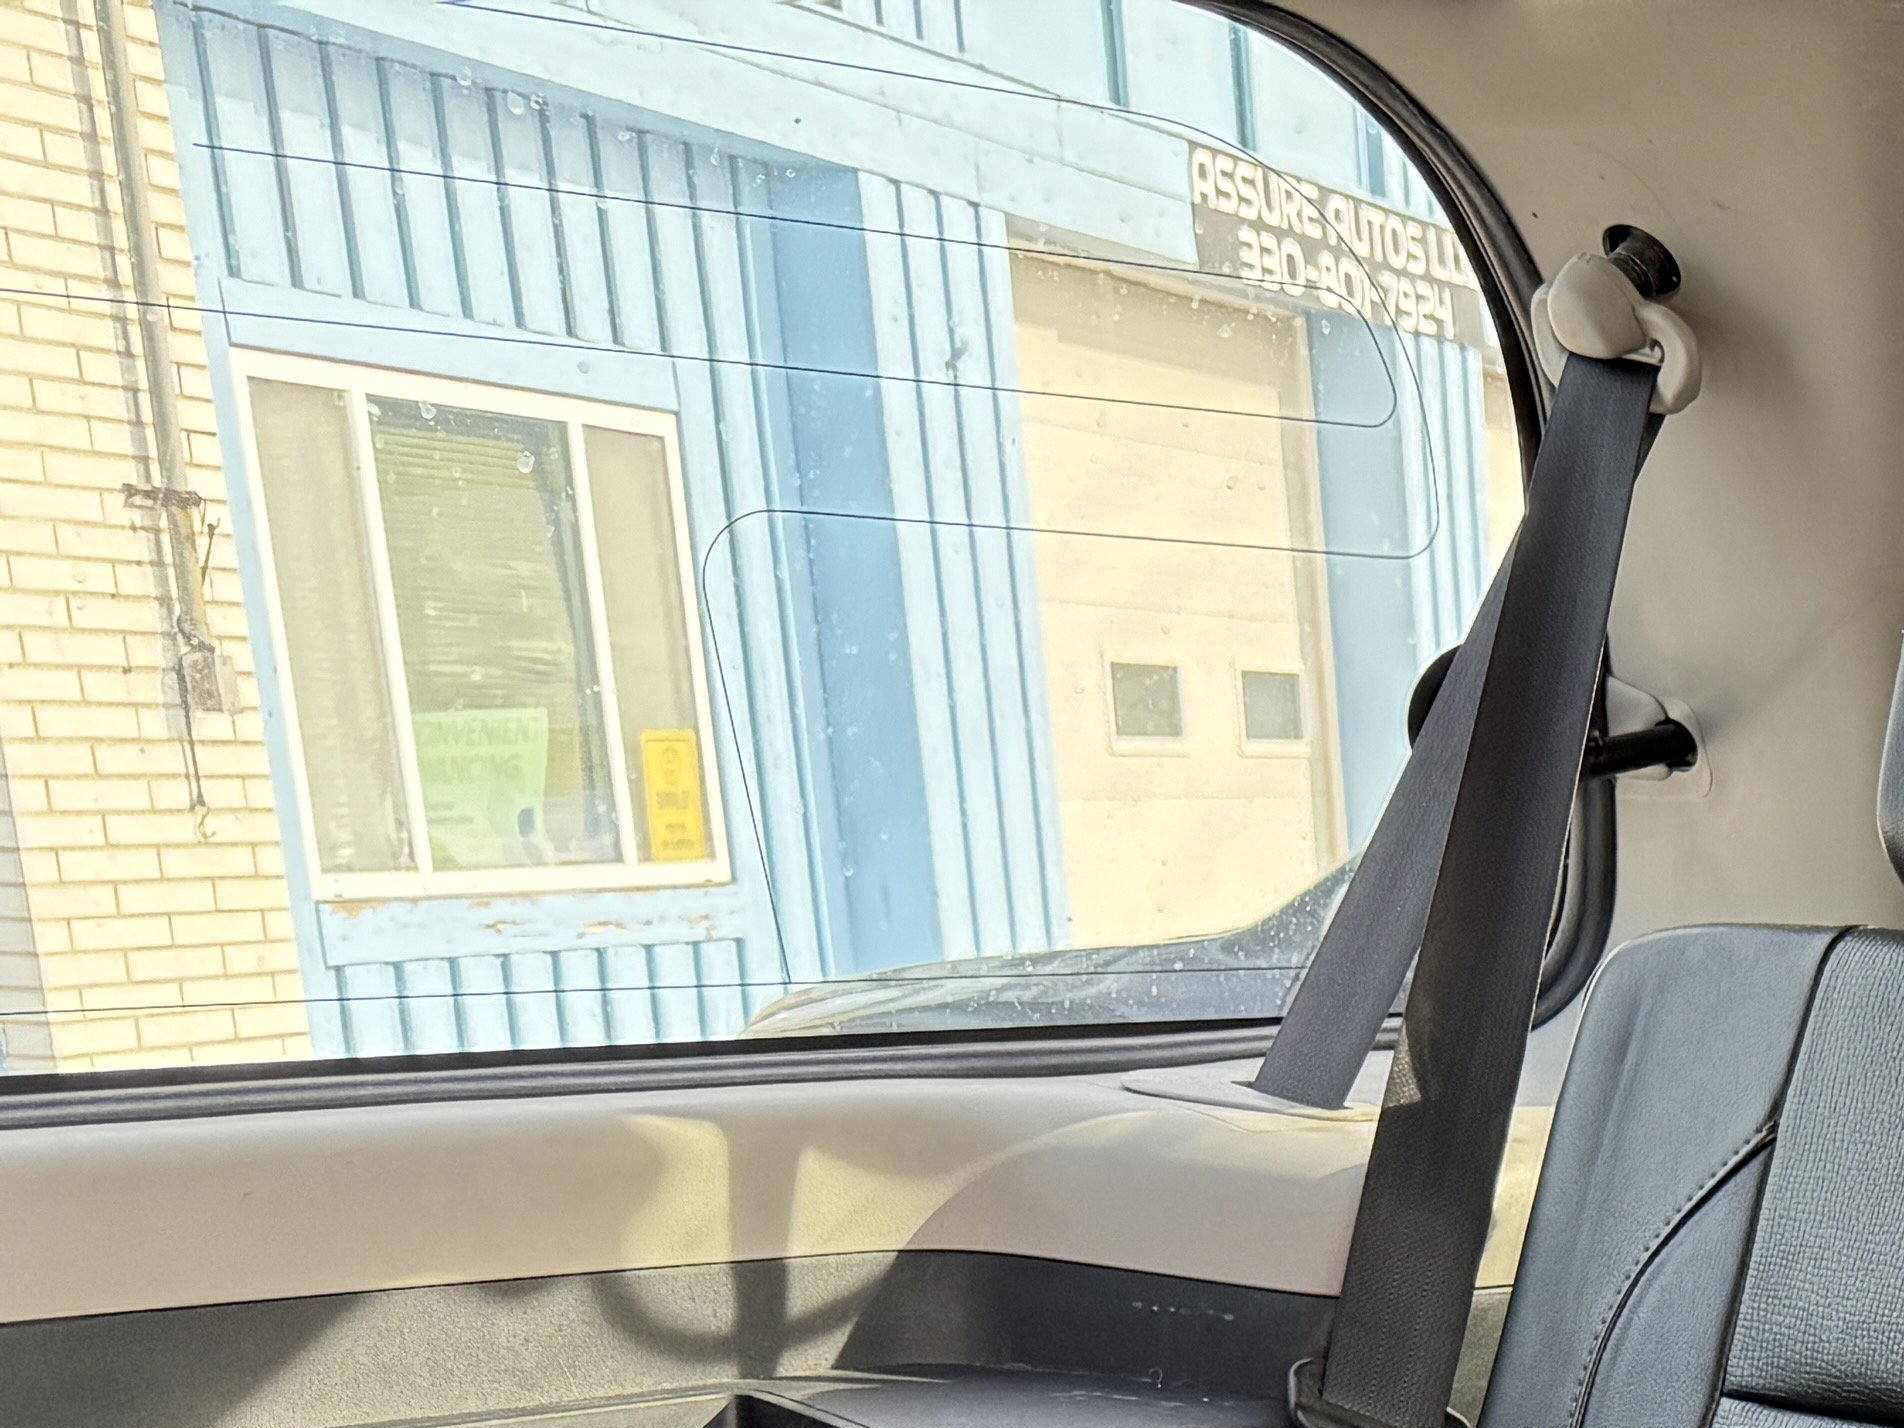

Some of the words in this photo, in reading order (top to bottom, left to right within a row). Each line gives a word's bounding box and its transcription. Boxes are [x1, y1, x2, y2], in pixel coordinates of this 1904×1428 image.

[1192, 149, 1320, 239] ASSURE
[1325, 193, 1427, 276] AUTOS
[1238, 226, 1455, 340] 330-801-7924
